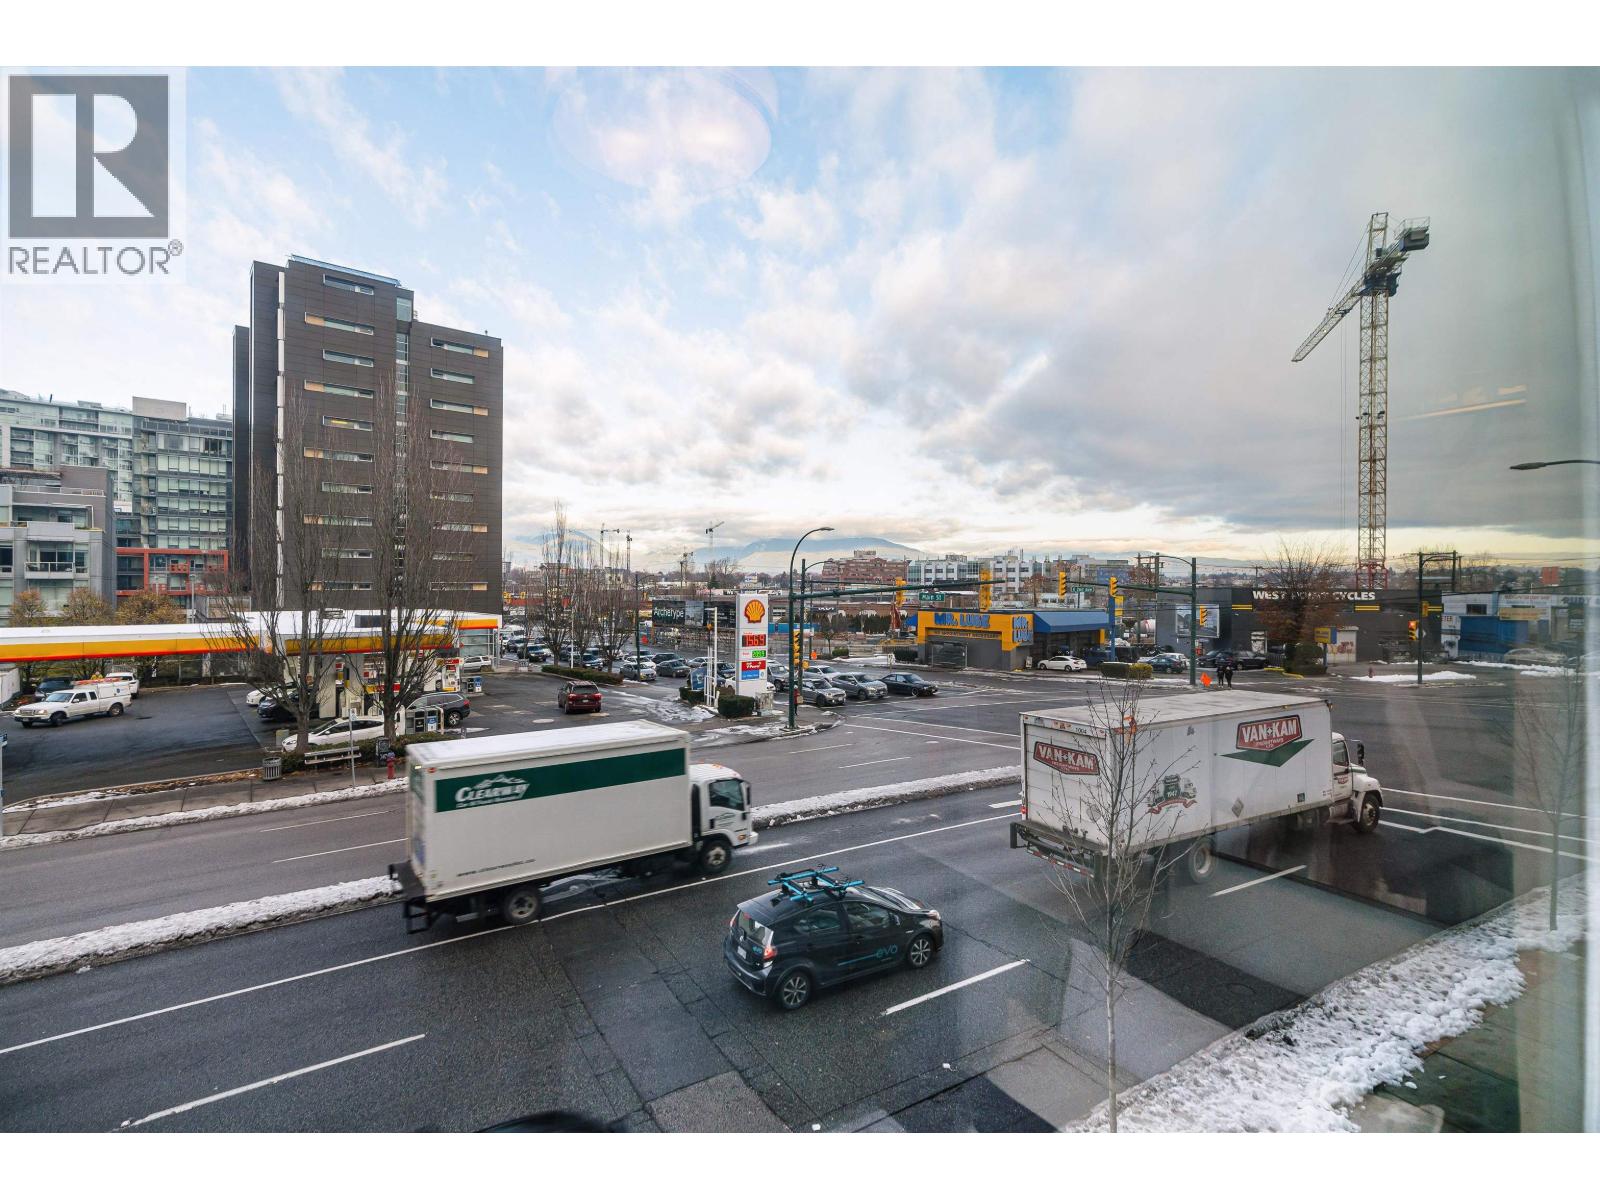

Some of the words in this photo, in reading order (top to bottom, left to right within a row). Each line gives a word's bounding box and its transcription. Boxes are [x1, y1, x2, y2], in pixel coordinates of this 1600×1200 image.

[1252, 590, 1287, 600] WEST
[1332, 591, 1376, 601] CYCLES
[653, 607, 684, 619] Archetype
